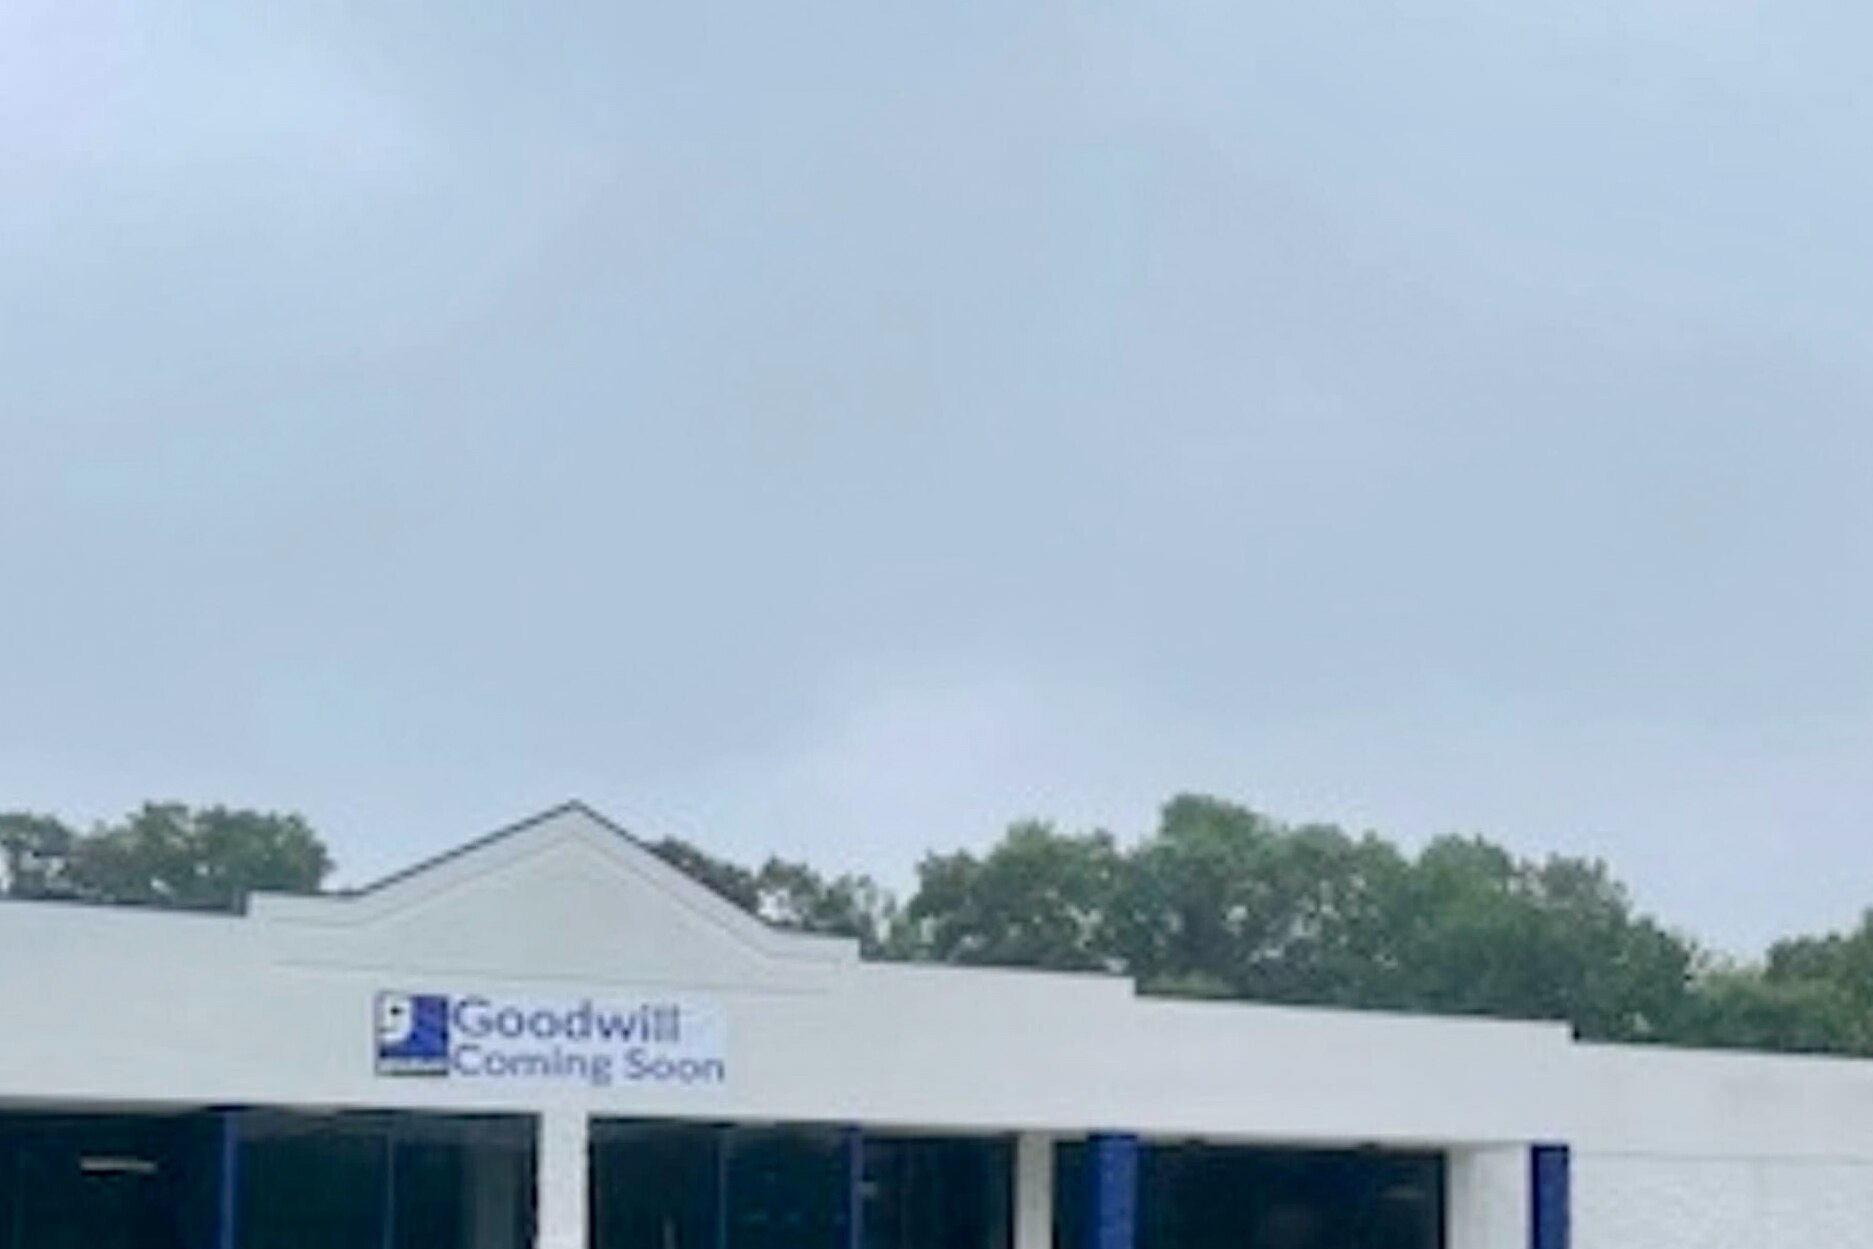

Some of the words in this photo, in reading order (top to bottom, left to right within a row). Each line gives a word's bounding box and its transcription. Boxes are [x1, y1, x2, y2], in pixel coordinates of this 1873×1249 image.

[452, 997, 681, 1042] Goodwill
[452, 1043, 615, 1086] Coming
[623, 1048, 726, 1084] Soon
